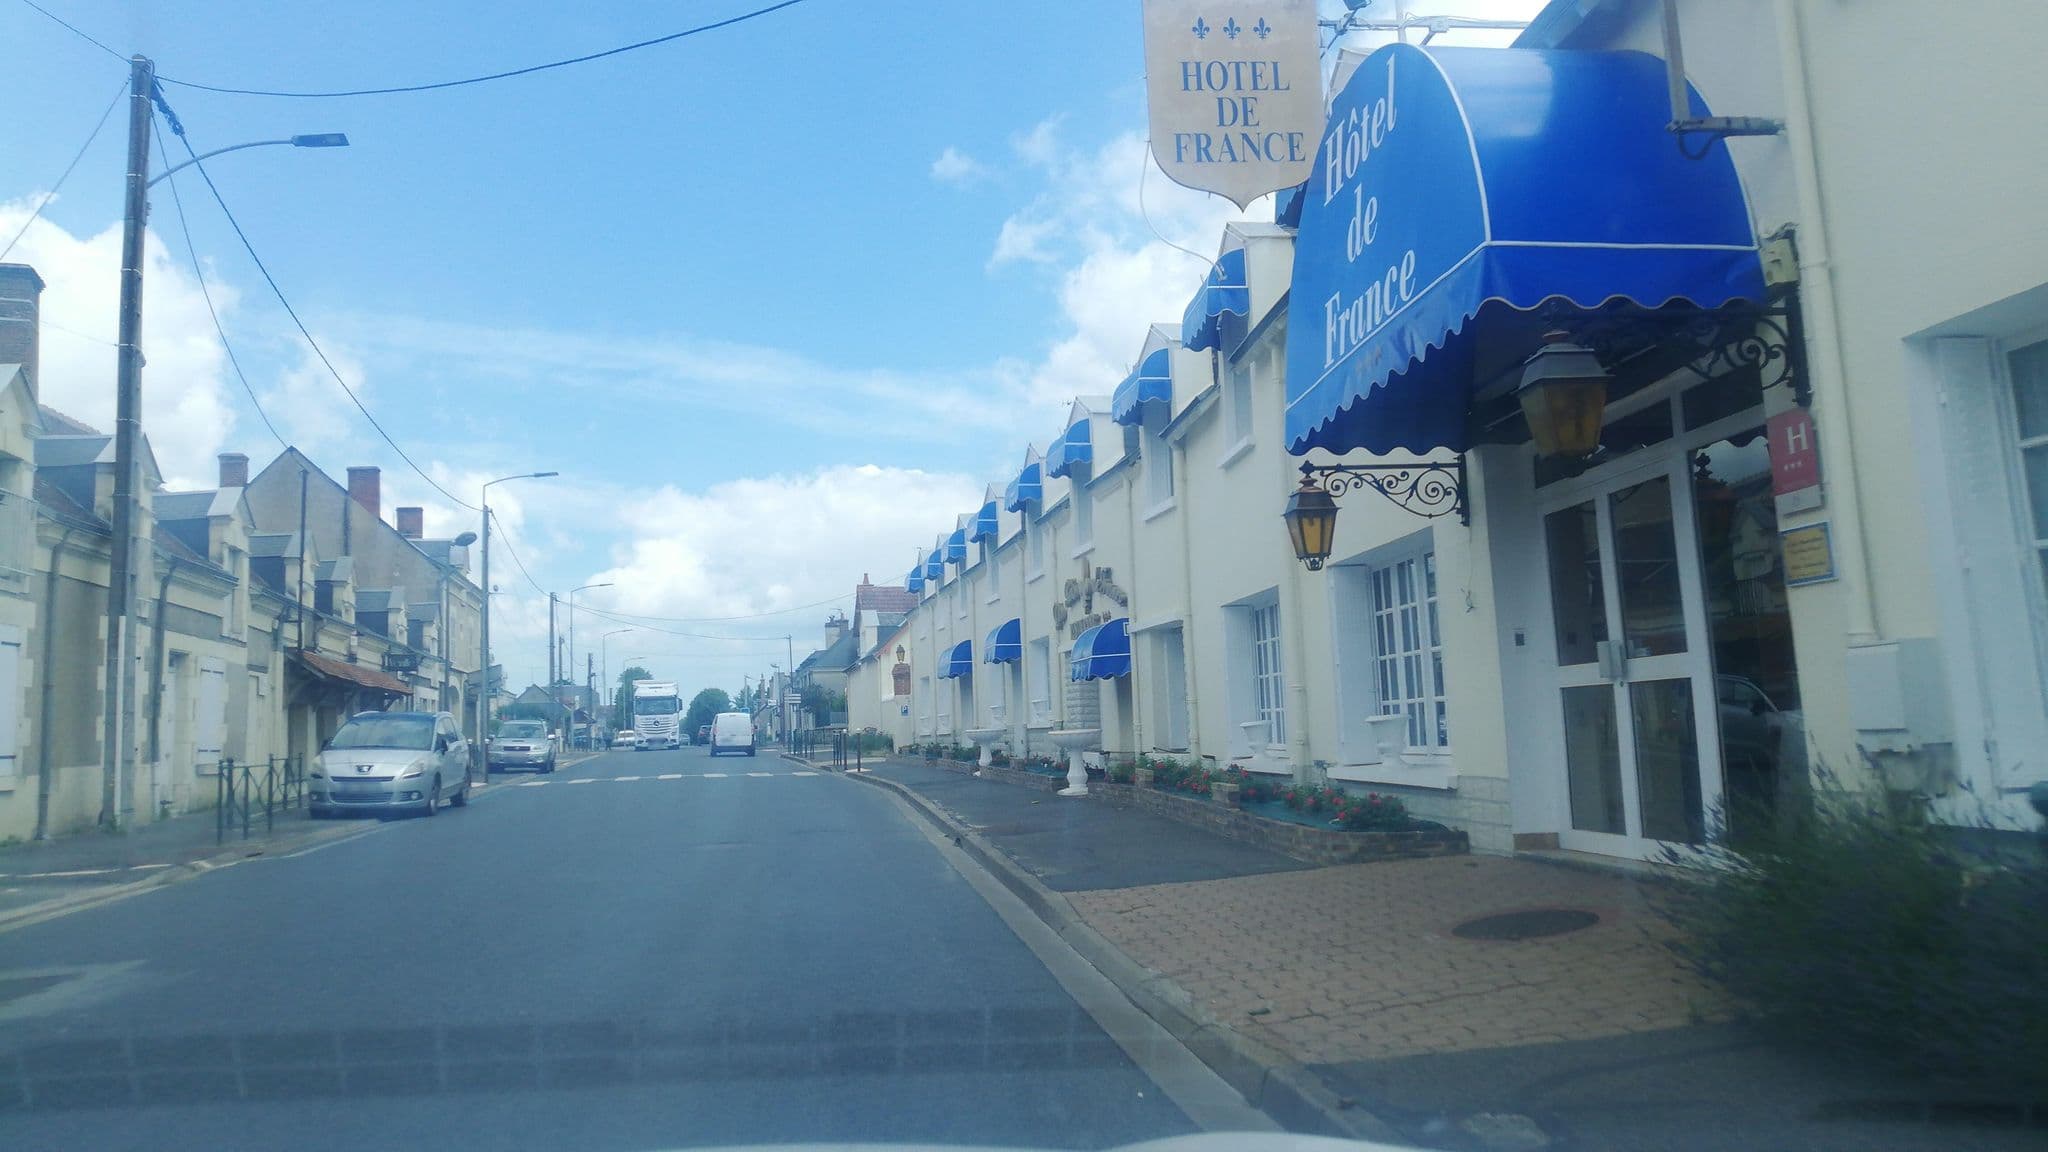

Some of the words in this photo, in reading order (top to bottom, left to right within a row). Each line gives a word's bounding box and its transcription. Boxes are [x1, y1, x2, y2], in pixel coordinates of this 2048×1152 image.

[1182, 61, 1290, 92] HOTEL
[1216, 96, 1260, 127] DE
[1174, 131, 1306, 163] FRANCE
[1324, 53, 1397, 207] Hôtel
[1346, 183, 1378, 263] de
[1324, 250, 1416, 369] France
[1786, 421, 1809, 455] H
